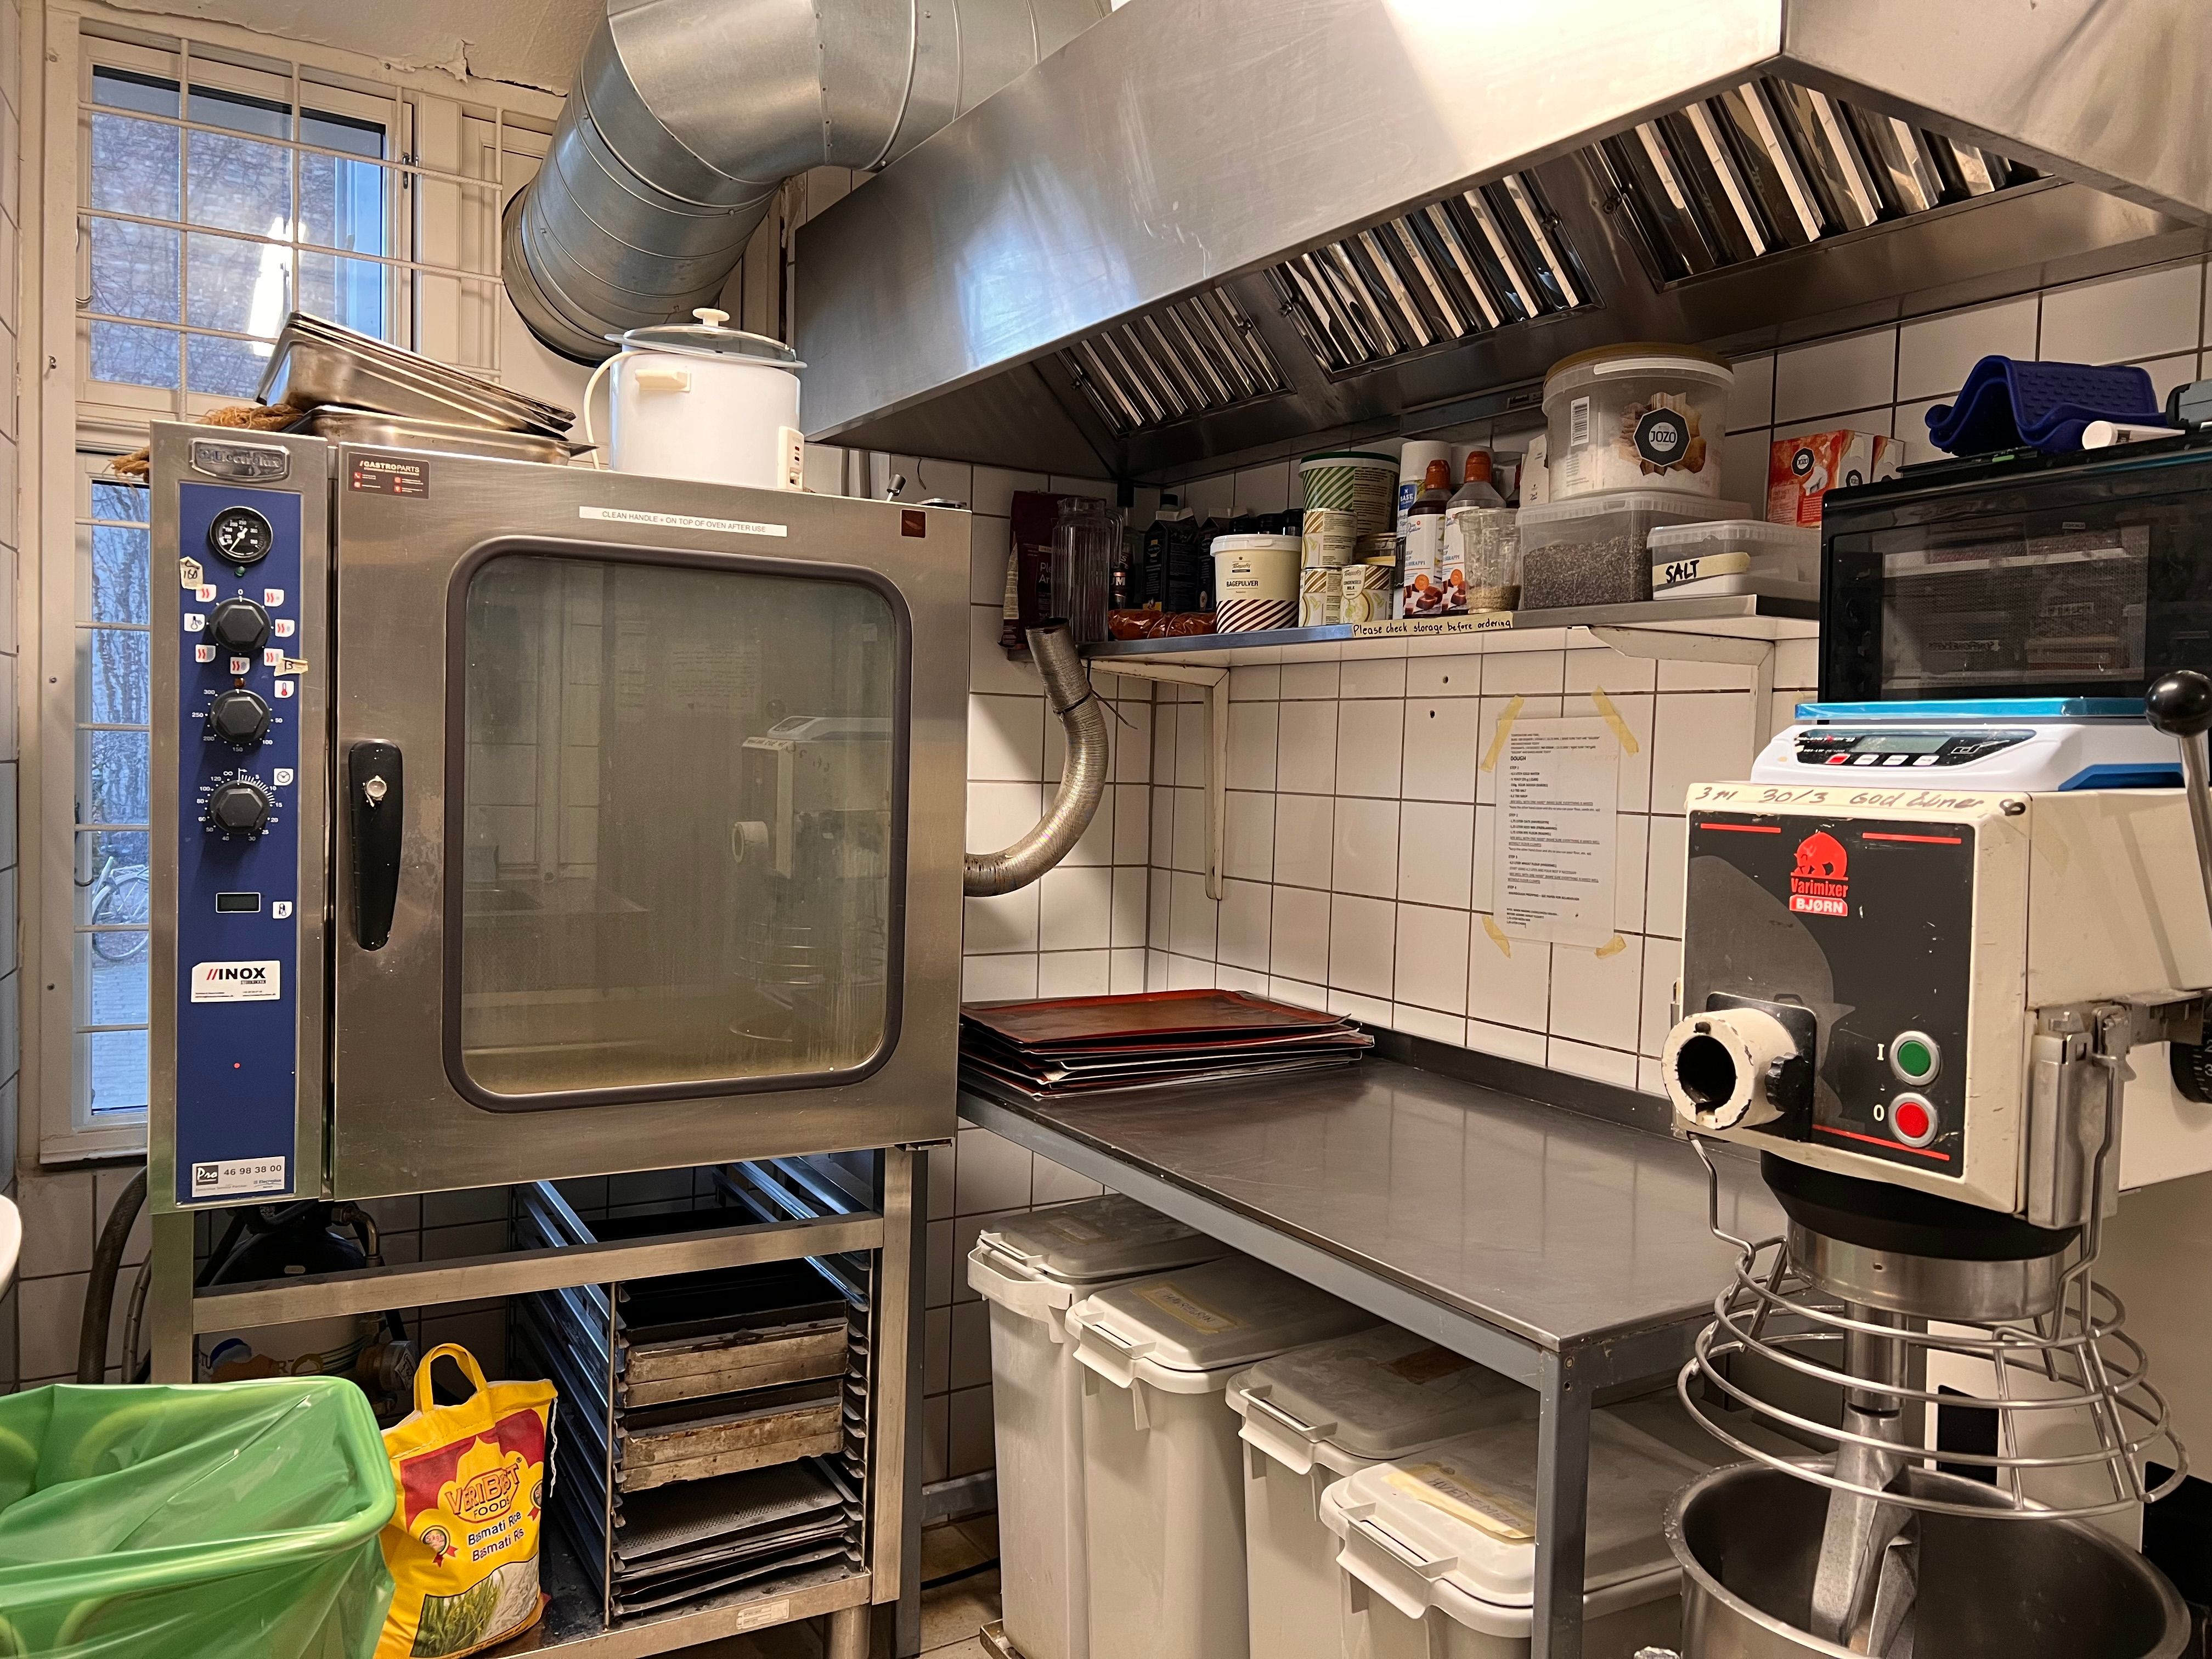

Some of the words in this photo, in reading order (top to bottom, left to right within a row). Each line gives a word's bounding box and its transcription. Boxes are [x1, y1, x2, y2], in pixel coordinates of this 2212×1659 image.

[1650, 431, 1676, 443] JOZO
[602, 511, 627, 519] CLEAN
[629, 514, 658, 522] HANDLE
[727, 523, 751, 531] AFTER
[1665, 559, 1700, 584] SALT
[1353, 624, 1382, 636] Please
[1386, 622, 1408, 633] check
[1413, 623, 1443, 634] storage
[1447, 621, 1473, 632] before
[1477, 618, 1511, 630] ordering
[1758, 789, 1829, 803] 30/3
[1849, 792, 1906, 807] God
[1791, 877, 1849, 898] Varimixer
[1796, 898, 1843, 913] BJØRN
[198, 1167, 217, 1181] Pro
[473, 1496, 510, 1519] FOODS
[468, 1519, 506, 1546] Basmati
[472, 1535, 511, 1562] Basmati
[514, 1528, 524, 1542] Ris
